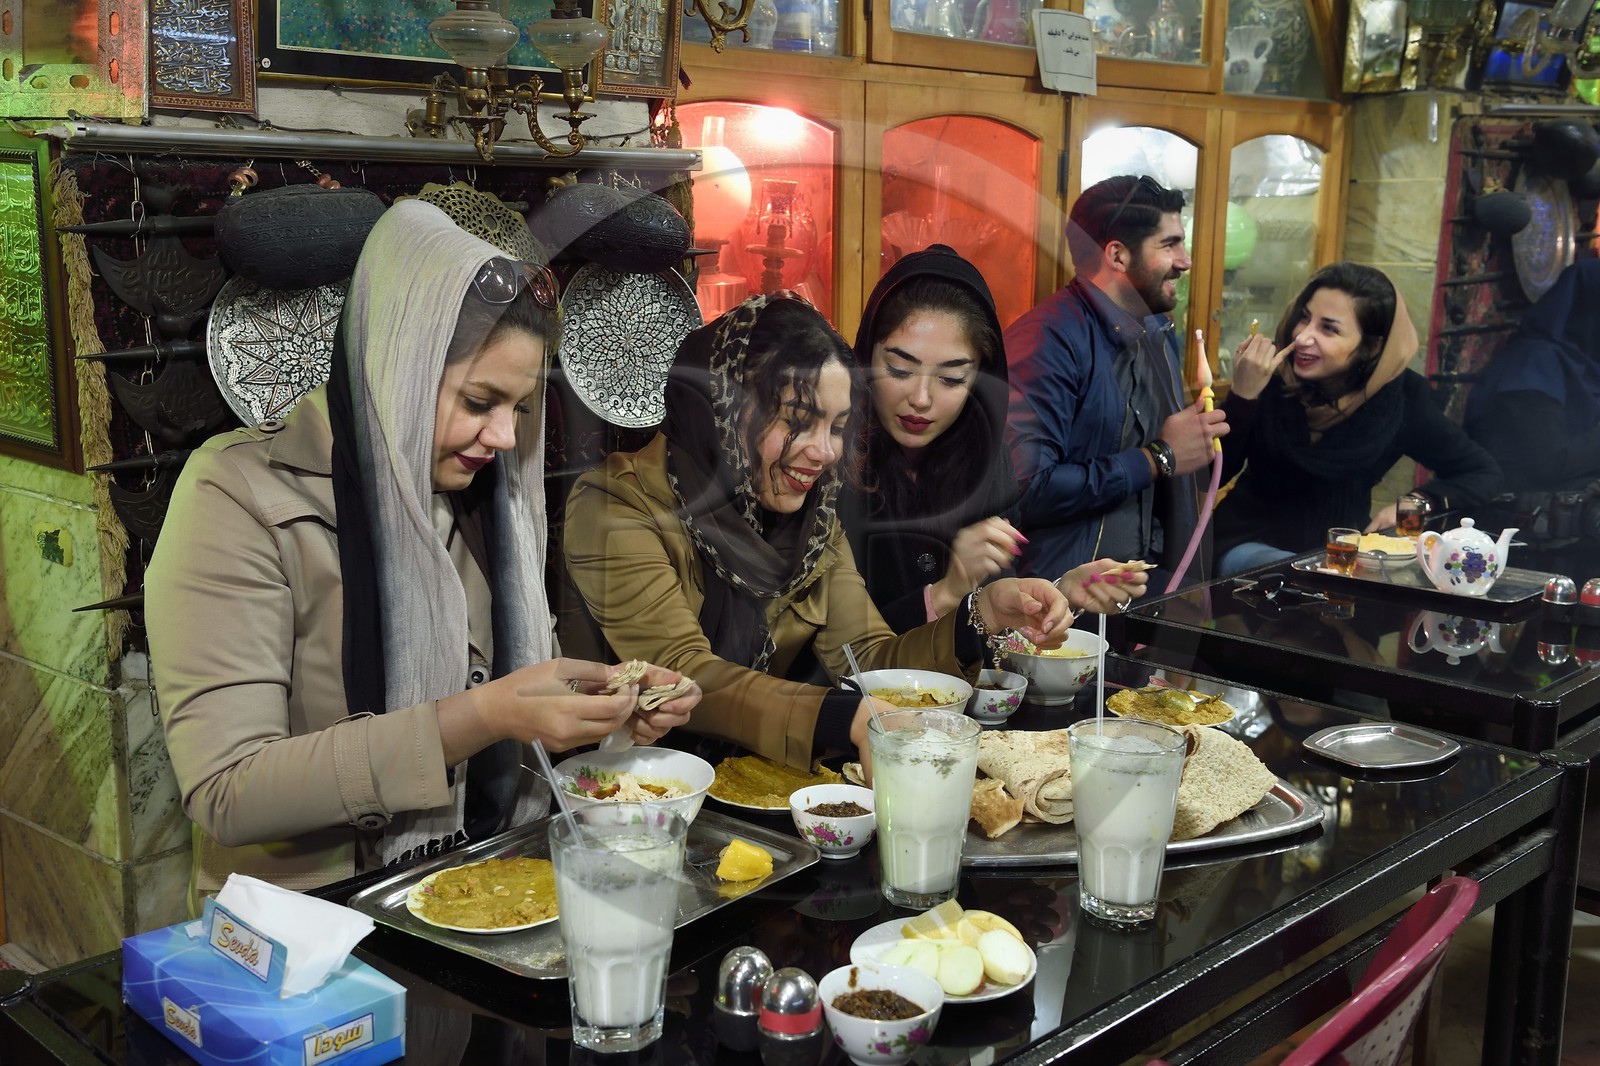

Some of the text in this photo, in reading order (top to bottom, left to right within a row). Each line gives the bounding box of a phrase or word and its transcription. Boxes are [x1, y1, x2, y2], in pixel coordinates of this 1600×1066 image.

[217, 922, 260, 967] Sevda
[166, 1005, 198, 1040] Sevda
[314, 1024, 364, 1058] سودا
